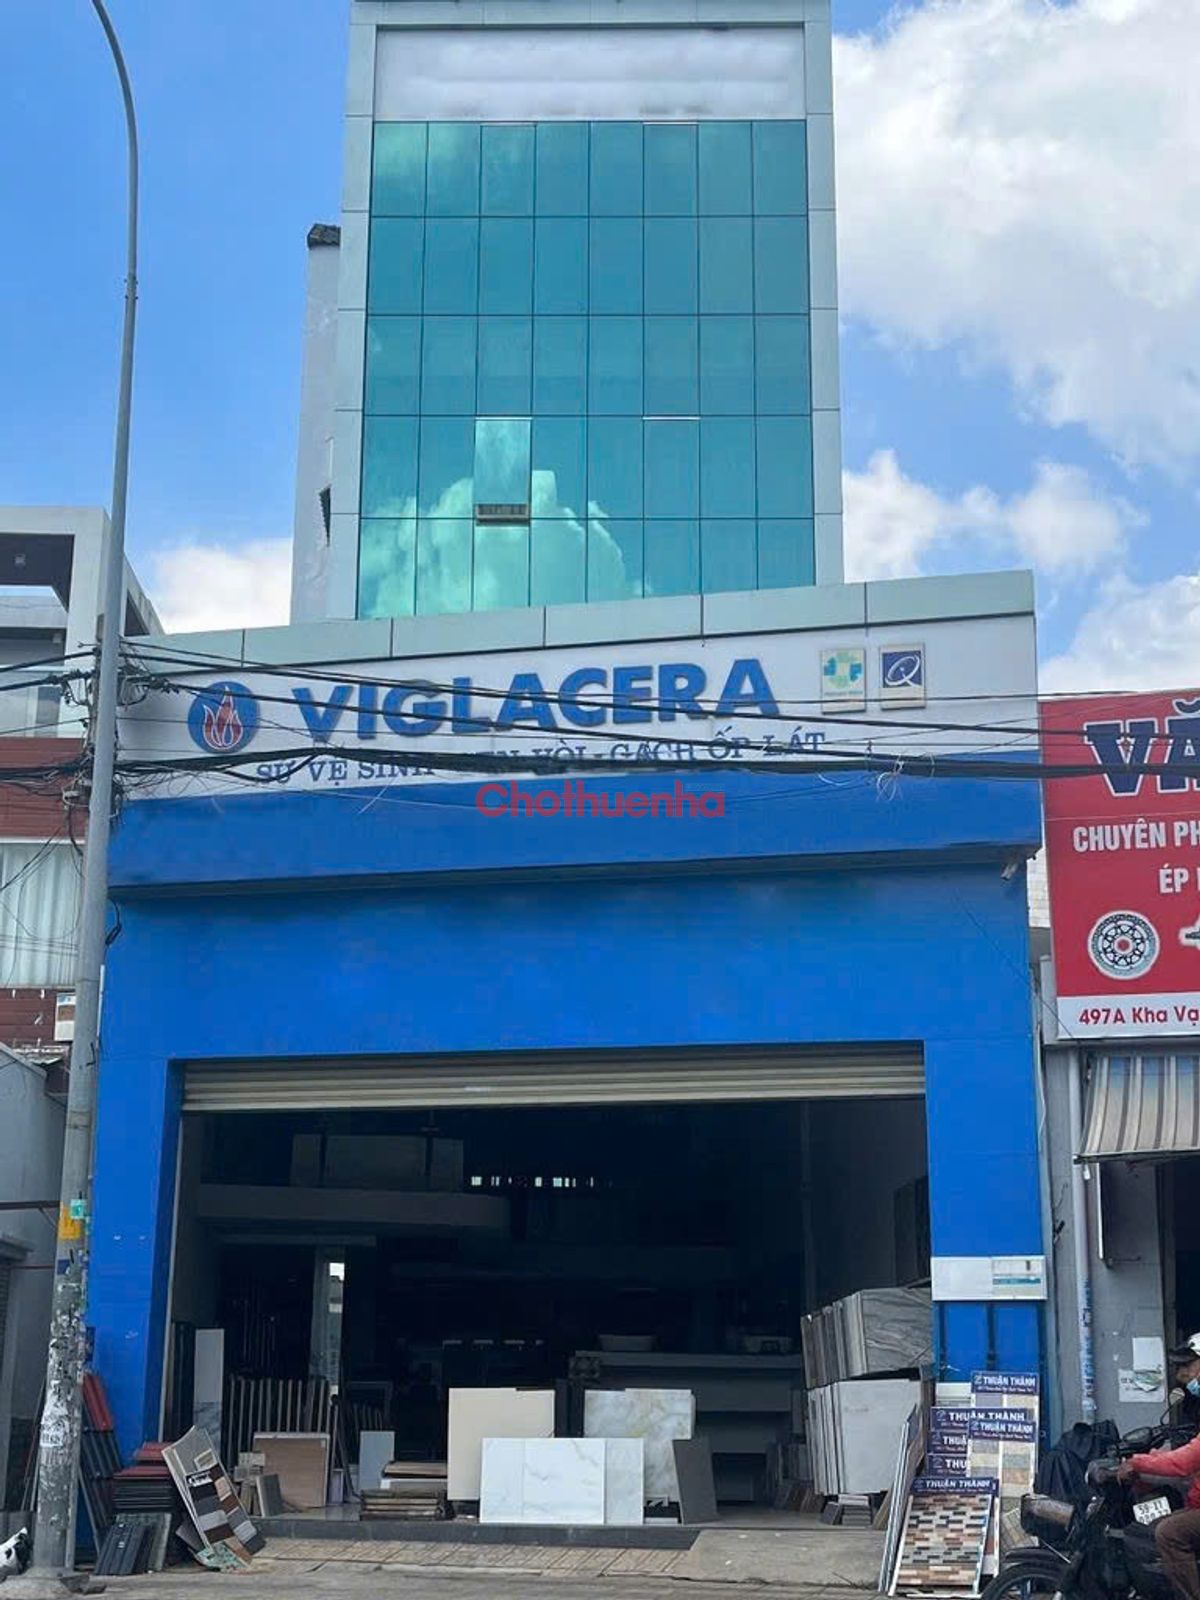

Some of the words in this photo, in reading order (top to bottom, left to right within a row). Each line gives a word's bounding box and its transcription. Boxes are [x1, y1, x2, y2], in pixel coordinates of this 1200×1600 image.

[291, 658, 780, 743] VIGLACERA
[1073, 818, 1167, 853] CHUYÊN
[1173, 820, 1200, 847] PH
[1159, 863, 1189, 893] ÉP
[1079, 1008, 1126, 1025] 497A
[1132, 1006, 1168, 1023] Kha
[1173, 1005, 1200, 1026] Vạ
